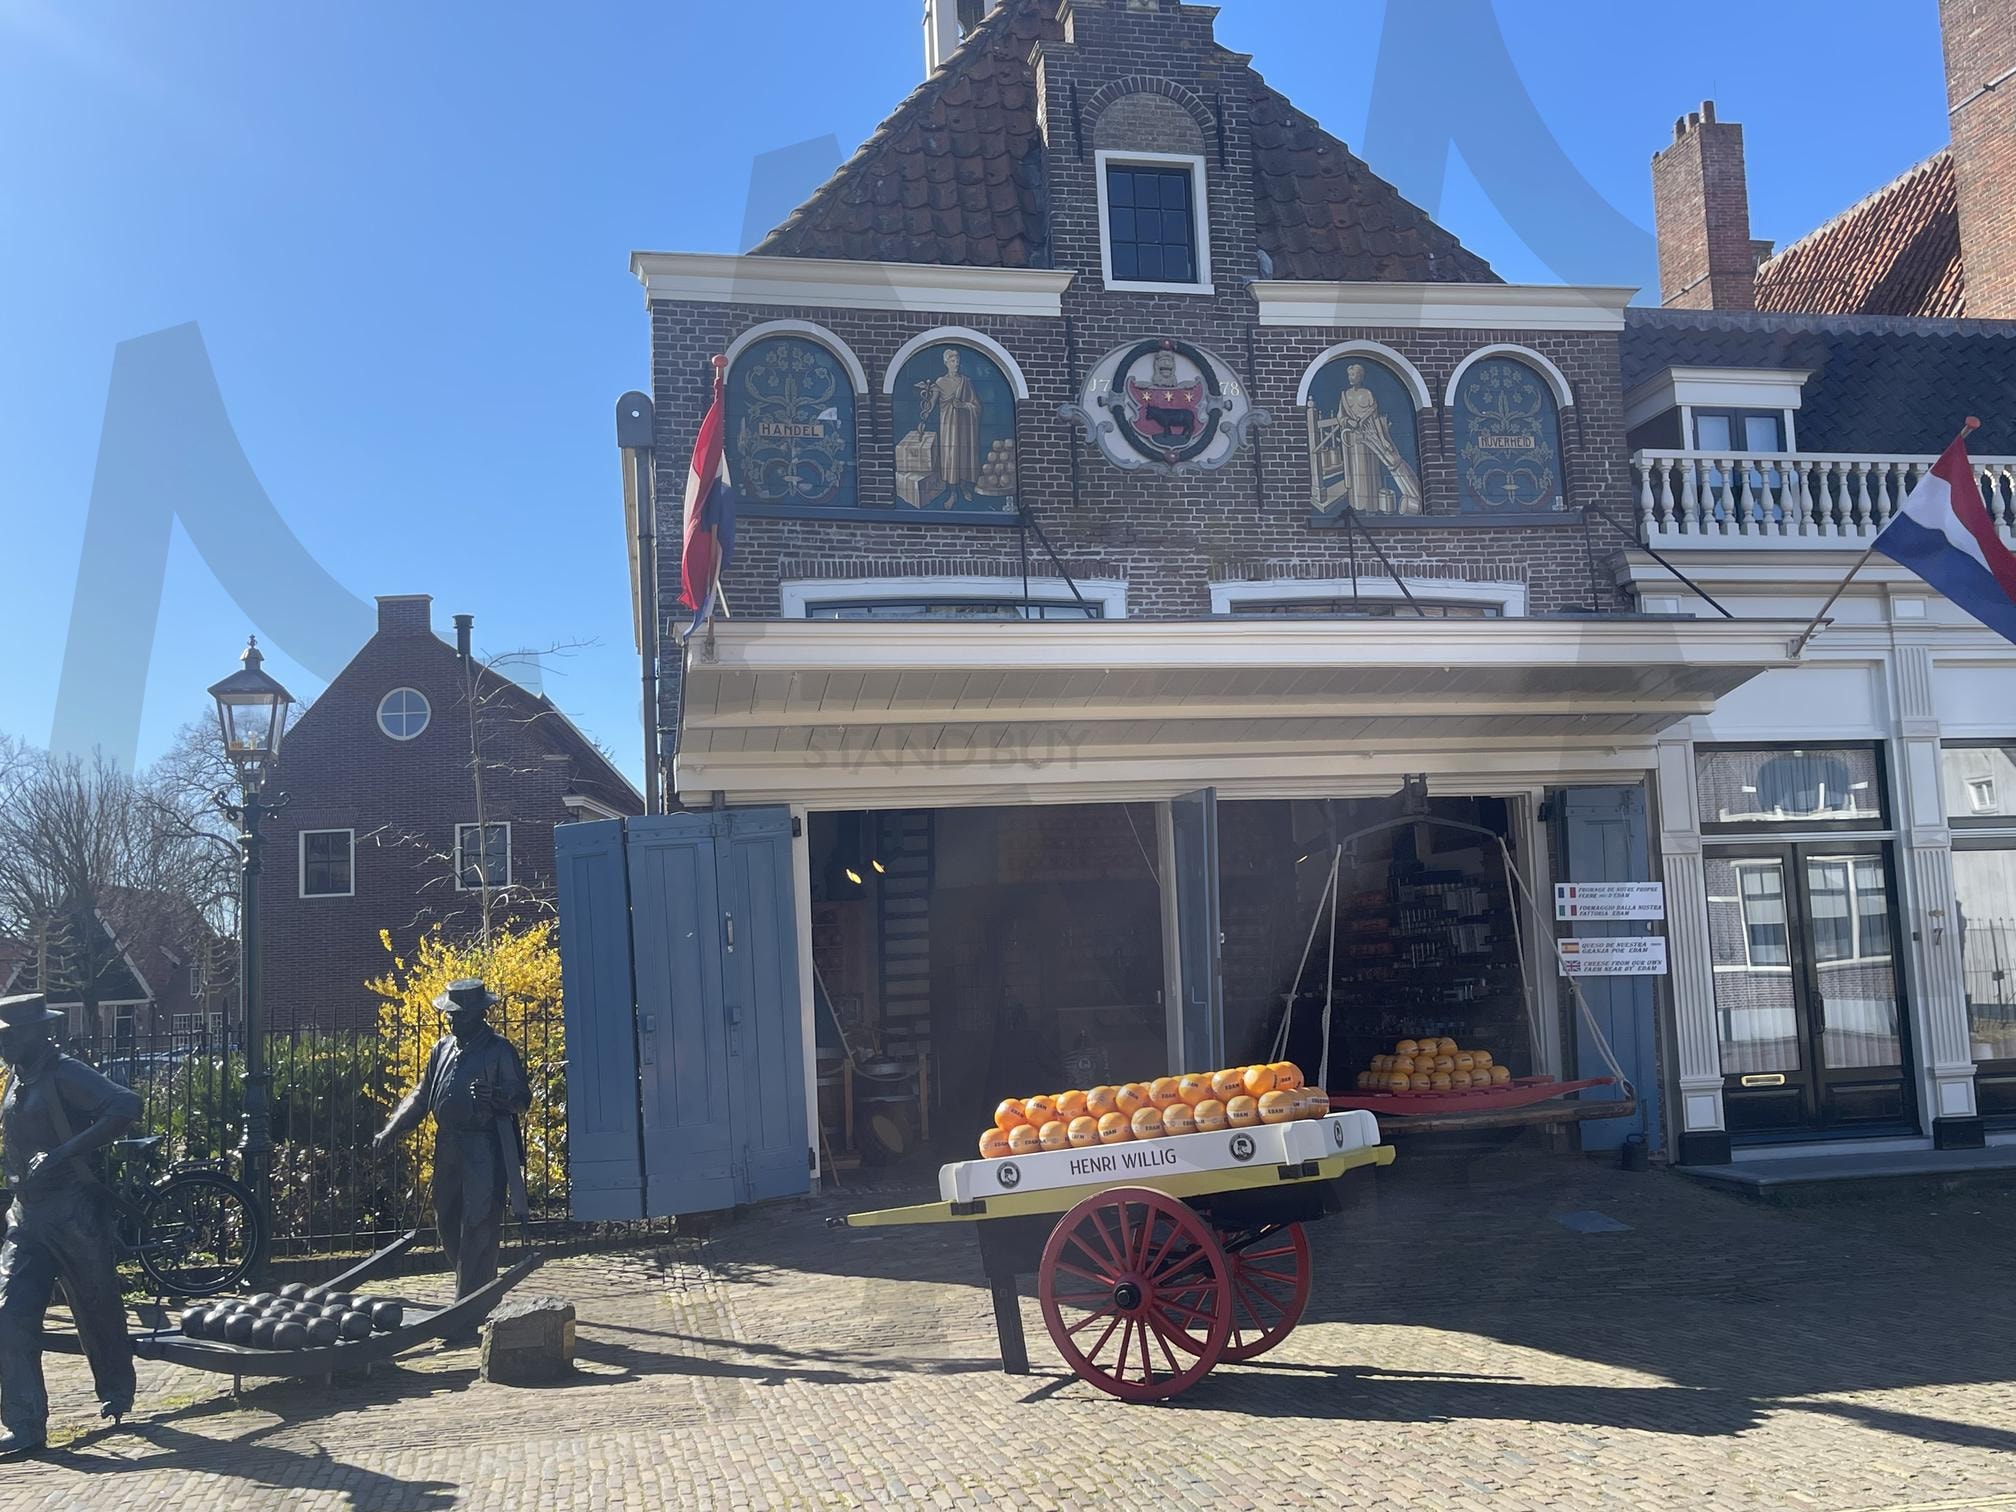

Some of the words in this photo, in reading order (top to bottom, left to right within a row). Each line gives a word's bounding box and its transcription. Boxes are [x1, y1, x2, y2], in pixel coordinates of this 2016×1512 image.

[1219, 380, 1240, 396] 78
[1933, 927, 1944, 946] 7
[1070, 1155, 1117, 1176] HENRI
[1121, 1148, 1177, 1169] WILLIG
